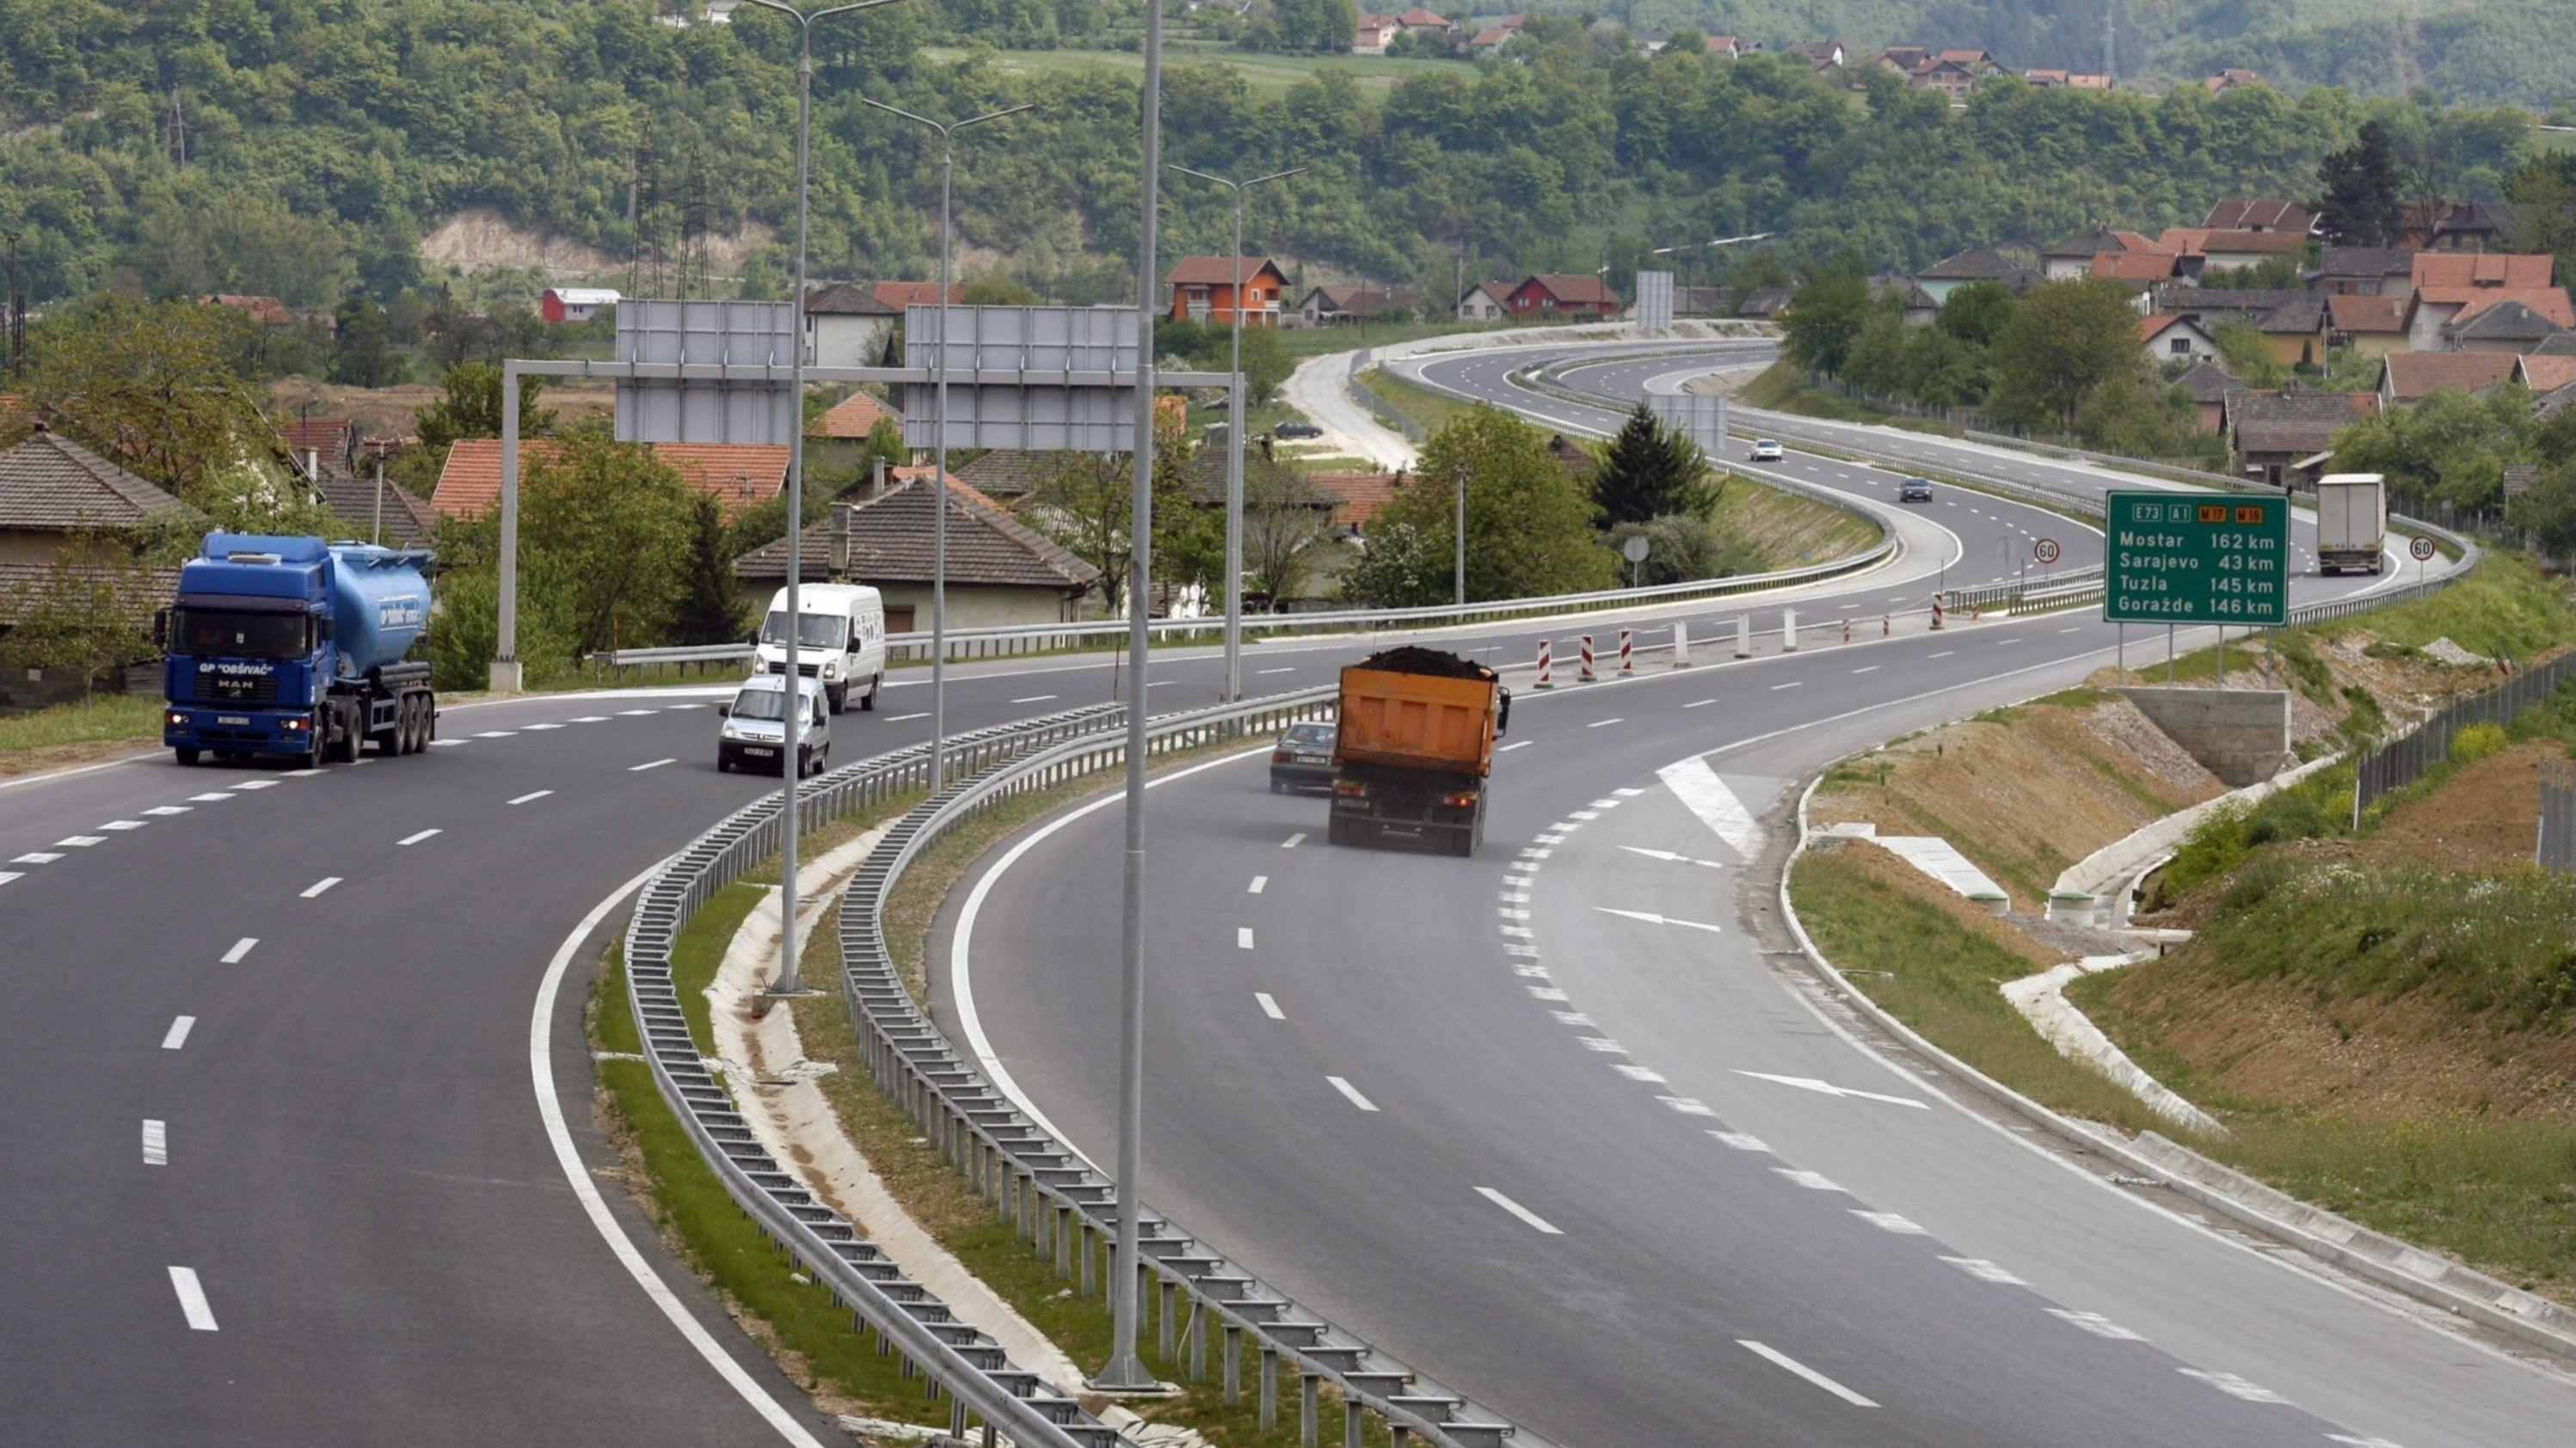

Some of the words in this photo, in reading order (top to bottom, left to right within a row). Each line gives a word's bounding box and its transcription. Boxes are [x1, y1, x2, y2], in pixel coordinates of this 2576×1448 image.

[2119, 532, 2184, 547] Mostar
[2211, 534, 2243, 549] 162
[2248, 535, 2274, 549] km
[2039, 544, 2055, 557] 60
[2414, 542, 2430, 555] 60
[2119, 553, 2198, 571] Sarajevo
[2218, 555, 2242, 570] 43
[2248, 556, 2273, 570] km
[2120, 575, 2167, 591] Tuzla
[2210, 578, 2241, 592] 145
[2247, 579, 2273, 593] km
[2118, 597, 2193, 612] Goražde
[2210, 598, 2241, 614] 146
[2247, 600, 2272, 614] km
[200, 663, 216, 672] GP
[218, 680, 253, 689] MAN
